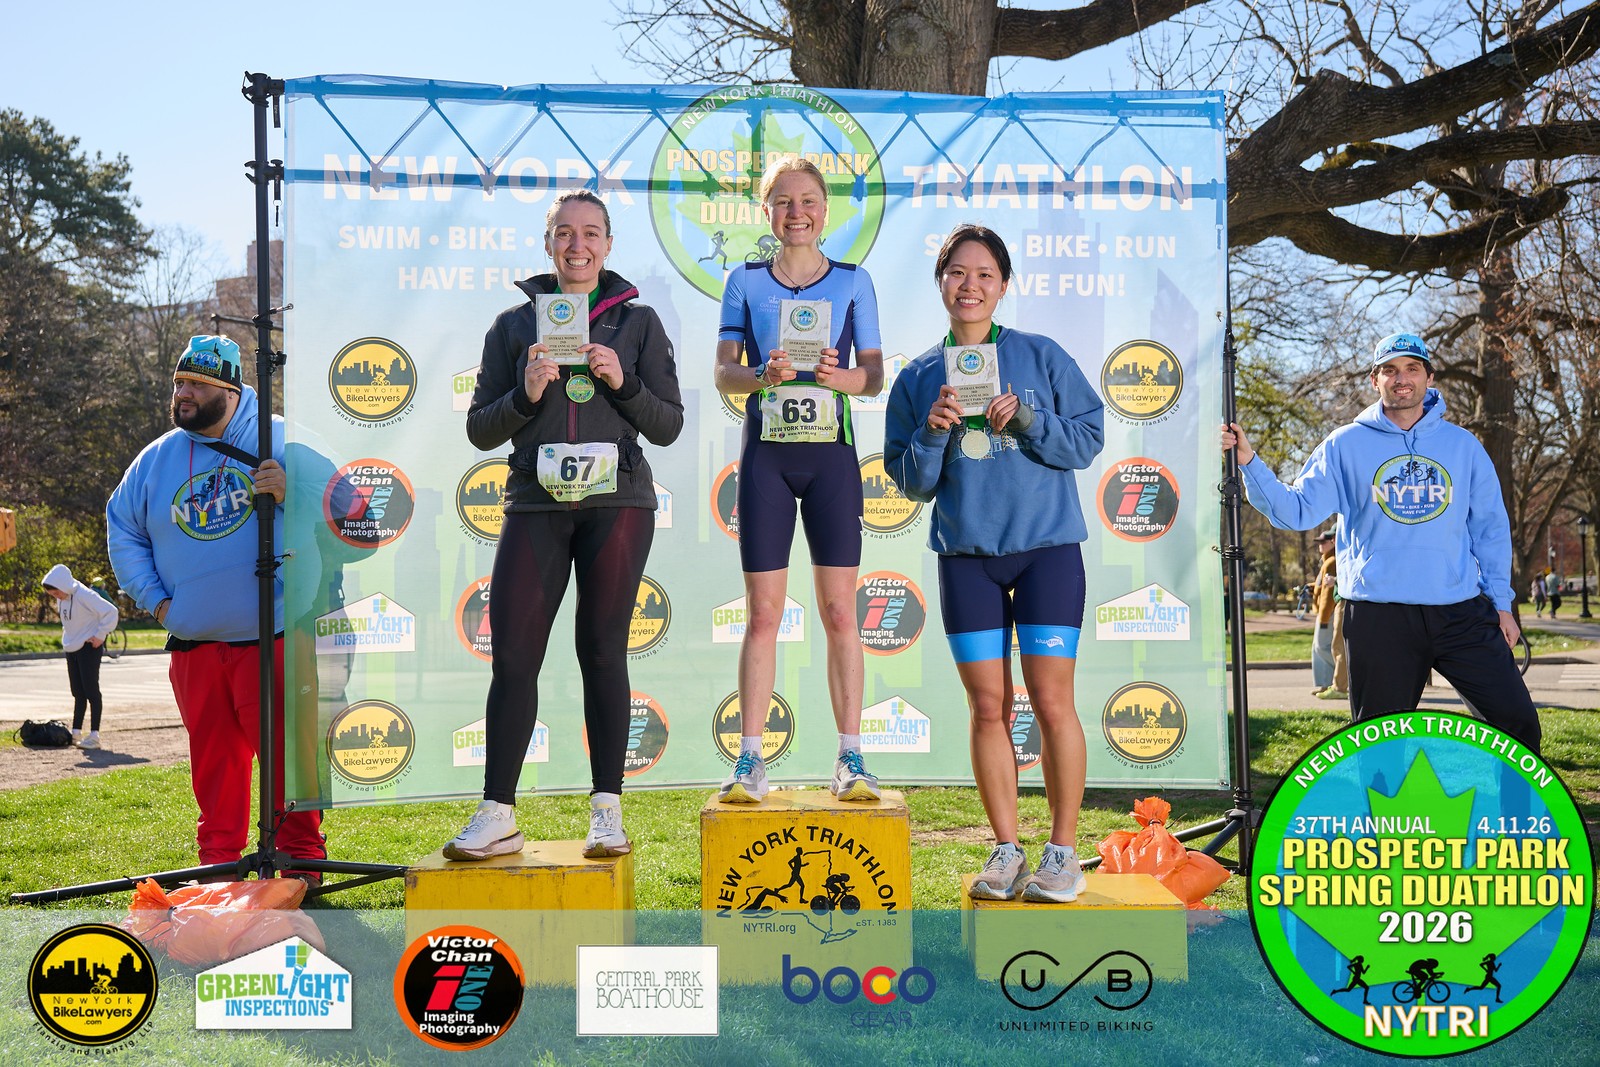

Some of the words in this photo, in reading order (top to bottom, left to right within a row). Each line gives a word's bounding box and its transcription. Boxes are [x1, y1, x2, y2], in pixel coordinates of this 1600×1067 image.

[681, 98, 717, 130] NEW
[719, 84, 765, 103] YORK
[770, 84, 858, 135] TRIATHLON
[323, 153, 458, 202] NEW
[472, 157, 635, 205] YORK
[903, 163, 1193, 212] TRIATHLON
[338, 225, 421, 250] SWIM
[449, 227, 517, 251] BIKE
[1026, 235, 1090, 258] BIKE
[1115, 236, 1175, 258] RUN
[398, 266, 474, 291] HAVE
[1059, 274, 1125, 296] FUN!
[346, 395, 400, 403] BikeLawyers
[1116, 394, 1166, 403] BikeLawyers
[332, 405, 355, 425] Flanzig
[404, 404, 415, 415] LLP
[782, 398, 817, 423] 63
[1104, 403, 1124, 424] Flanzig
[1170, 403, 1181, 415] LLP
[347, 466, 396, 474] Victor
[561, 456, 596, 482] 67
[1117, 464, 1163, 472] Victor
[349, 476, 392, 485] Chan
[1120, 474, 1159, 483] Chan
[1371, 483, 1454, 504] NYTRI
[864, 507, 909, 515] ikeLawyers
[345, 520, 380, 529] Imaging
[913, 516, 923, 527] LLP
[1116, 515, 1150, 524] Imaging
[341, 529, 398, 537] Photography
[1113, 523, 1165, 532] Photography
[460, 525, 482, 544] Flanzig
[863, 578, 909, 586] Victor
[866, 588, 905, 596] Chan
[1113, 622, 1177, 633] INSPECTIONS
[861, 629, 894, 638] Imaging
[334, 633, 401, 646] INSPECTIONS
[660, 636, 669, 648] LLP
[860, 735, 917, 745] NSPECTIONS
[1119, 737, 1171, 745] BikeLawyers
[783, 750, 792, 760] LLP
[1106, 746, 1127, 766] Flanzig
[1175, 746, 1185, 758] LLP
[344, 757, 398, 766] BikeLawyers
[331, 770, 353, 789] Flanzig
[403, 765, 412, 777] LLP
[716, 867, 743, 919] NEW
[739, 826, 798, 864] YORK
[806, 825, 898, 916] TRIATHLON
[743, 922, 797, 935] NYTRI.org
